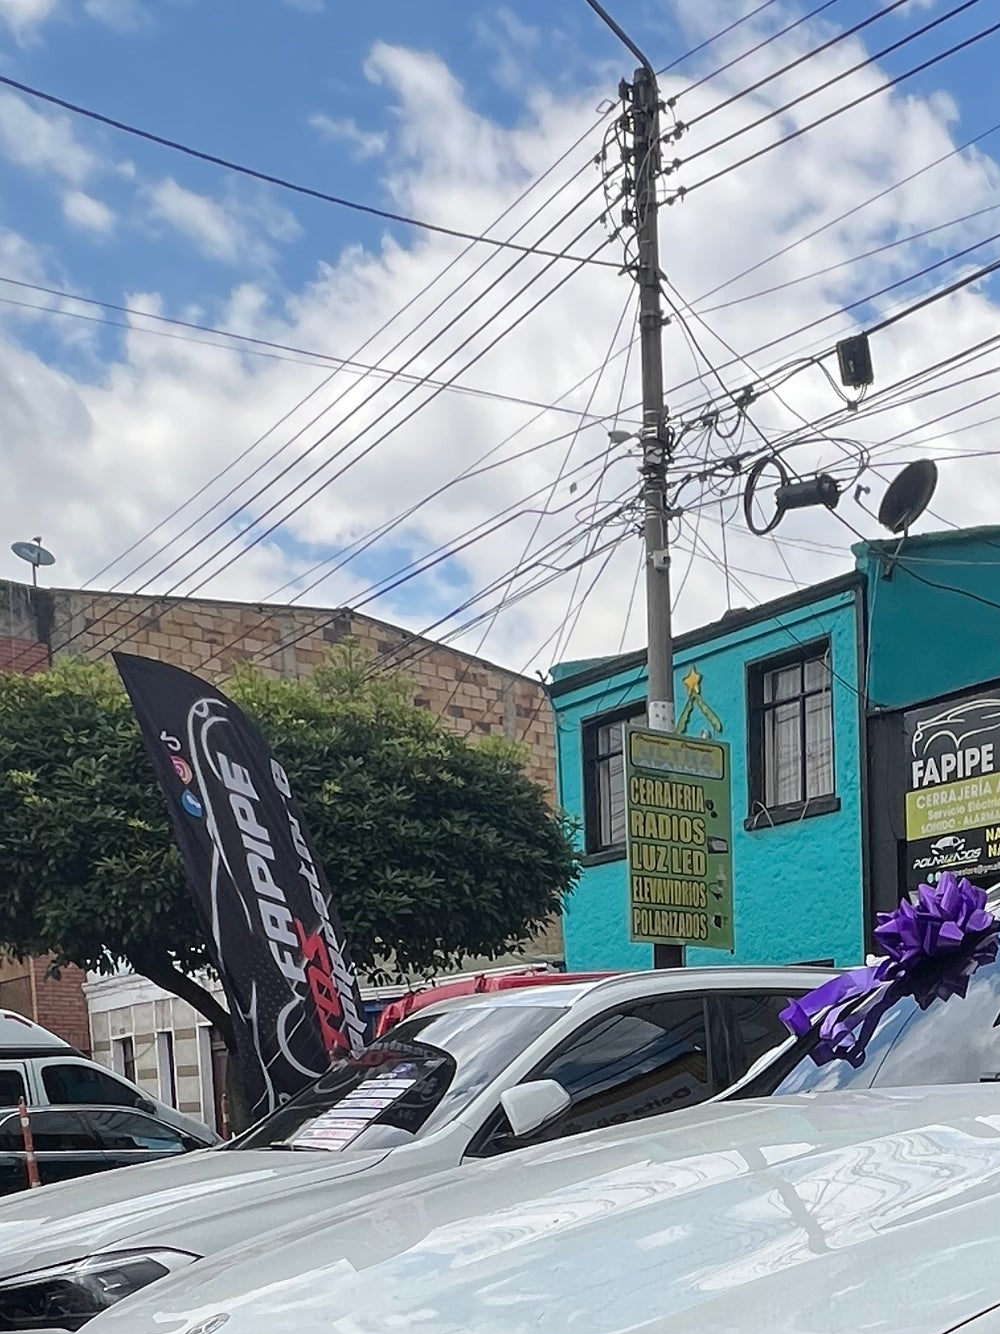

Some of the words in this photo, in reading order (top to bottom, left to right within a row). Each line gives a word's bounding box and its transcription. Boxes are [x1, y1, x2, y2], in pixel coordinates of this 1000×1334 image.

[912, 743, 994, 789] FAPIPE
[631, 776, 705, 813] CERRAJERIA
[916, 777, 992, 810] CERRAJERÍA
[631, 809, 706, 846] RADIOS
[920, 818, 956, 835] SONIDO
[927, 802, 966, 821] Servicio
[216, 751, 307, 983] FAPIPE
[631, 842, 668, 873] LUZ
[671, 846, 707, 877] LED
[913, 847, 982, 870] POLARIZADOS
[632, 875, 707, 909] ELEVAVIDRIOS
[632, 907, 708, 940] POLARIZADOS
